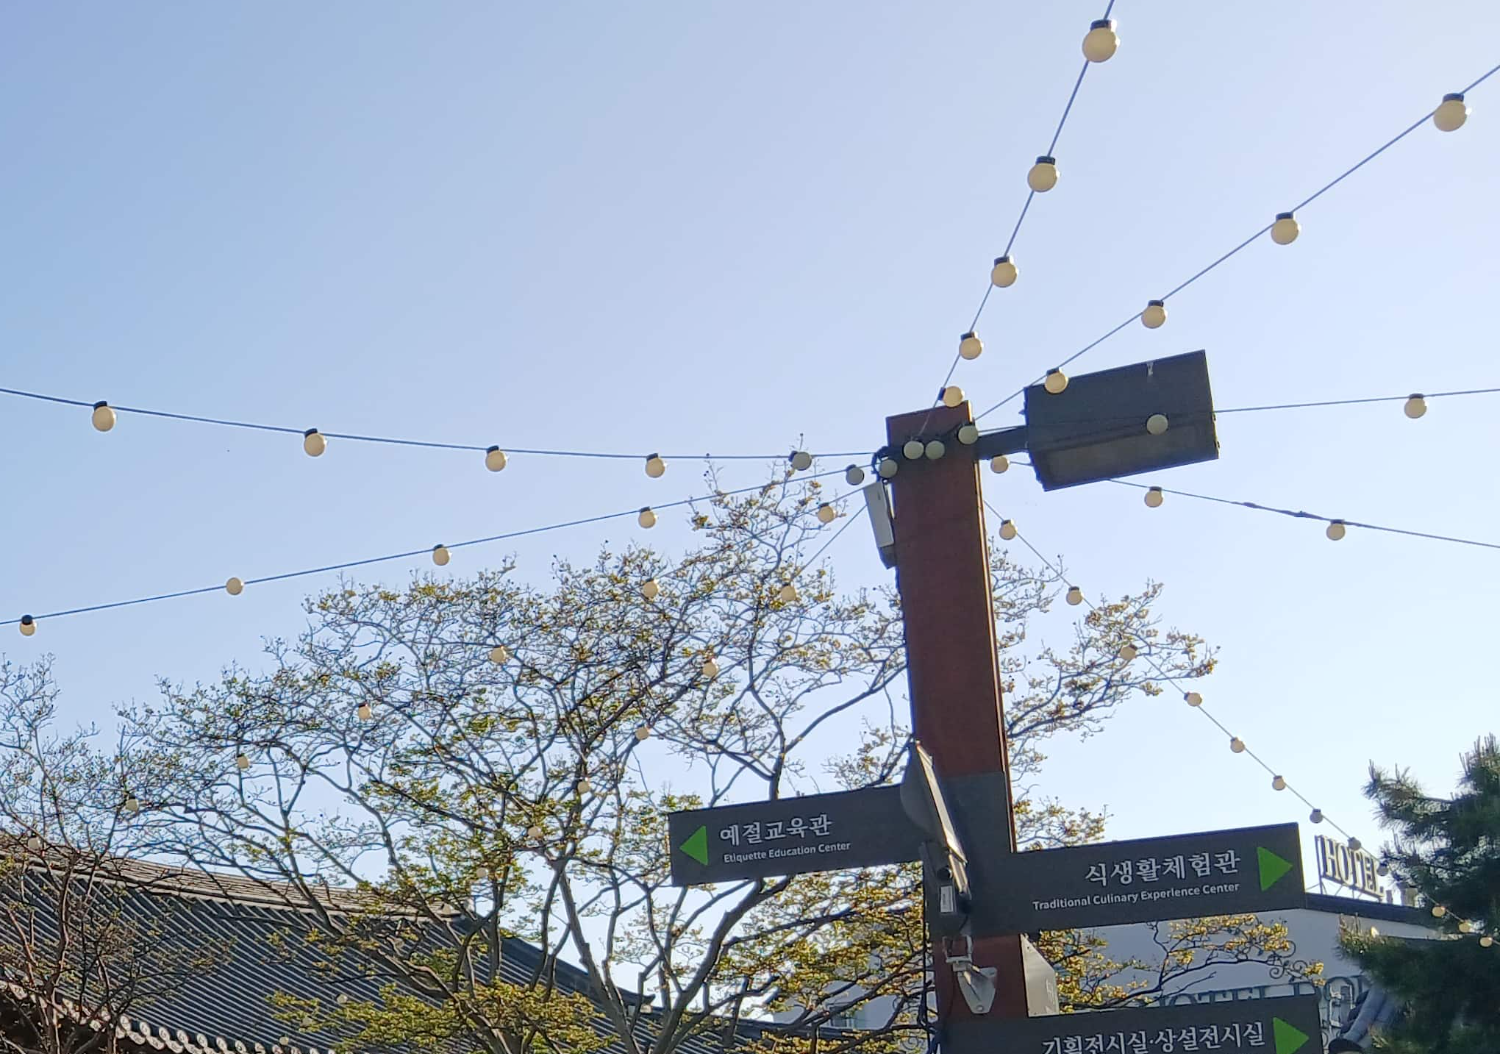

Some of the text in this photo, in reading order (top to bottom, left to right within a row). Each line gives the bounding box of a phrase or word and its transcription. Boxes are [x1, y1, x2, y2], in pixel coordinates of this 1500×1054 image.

[719, 814, 833, 846] 예절교육관
[723, 842, 851, 864] Etiquette Education Center
[1084, 849, 1241, 887] 식생활체험관
[1315, 835, 1386, 898] HOTEL
[1032, 882, 1240, 911] Traditional Culinary Experience Center
